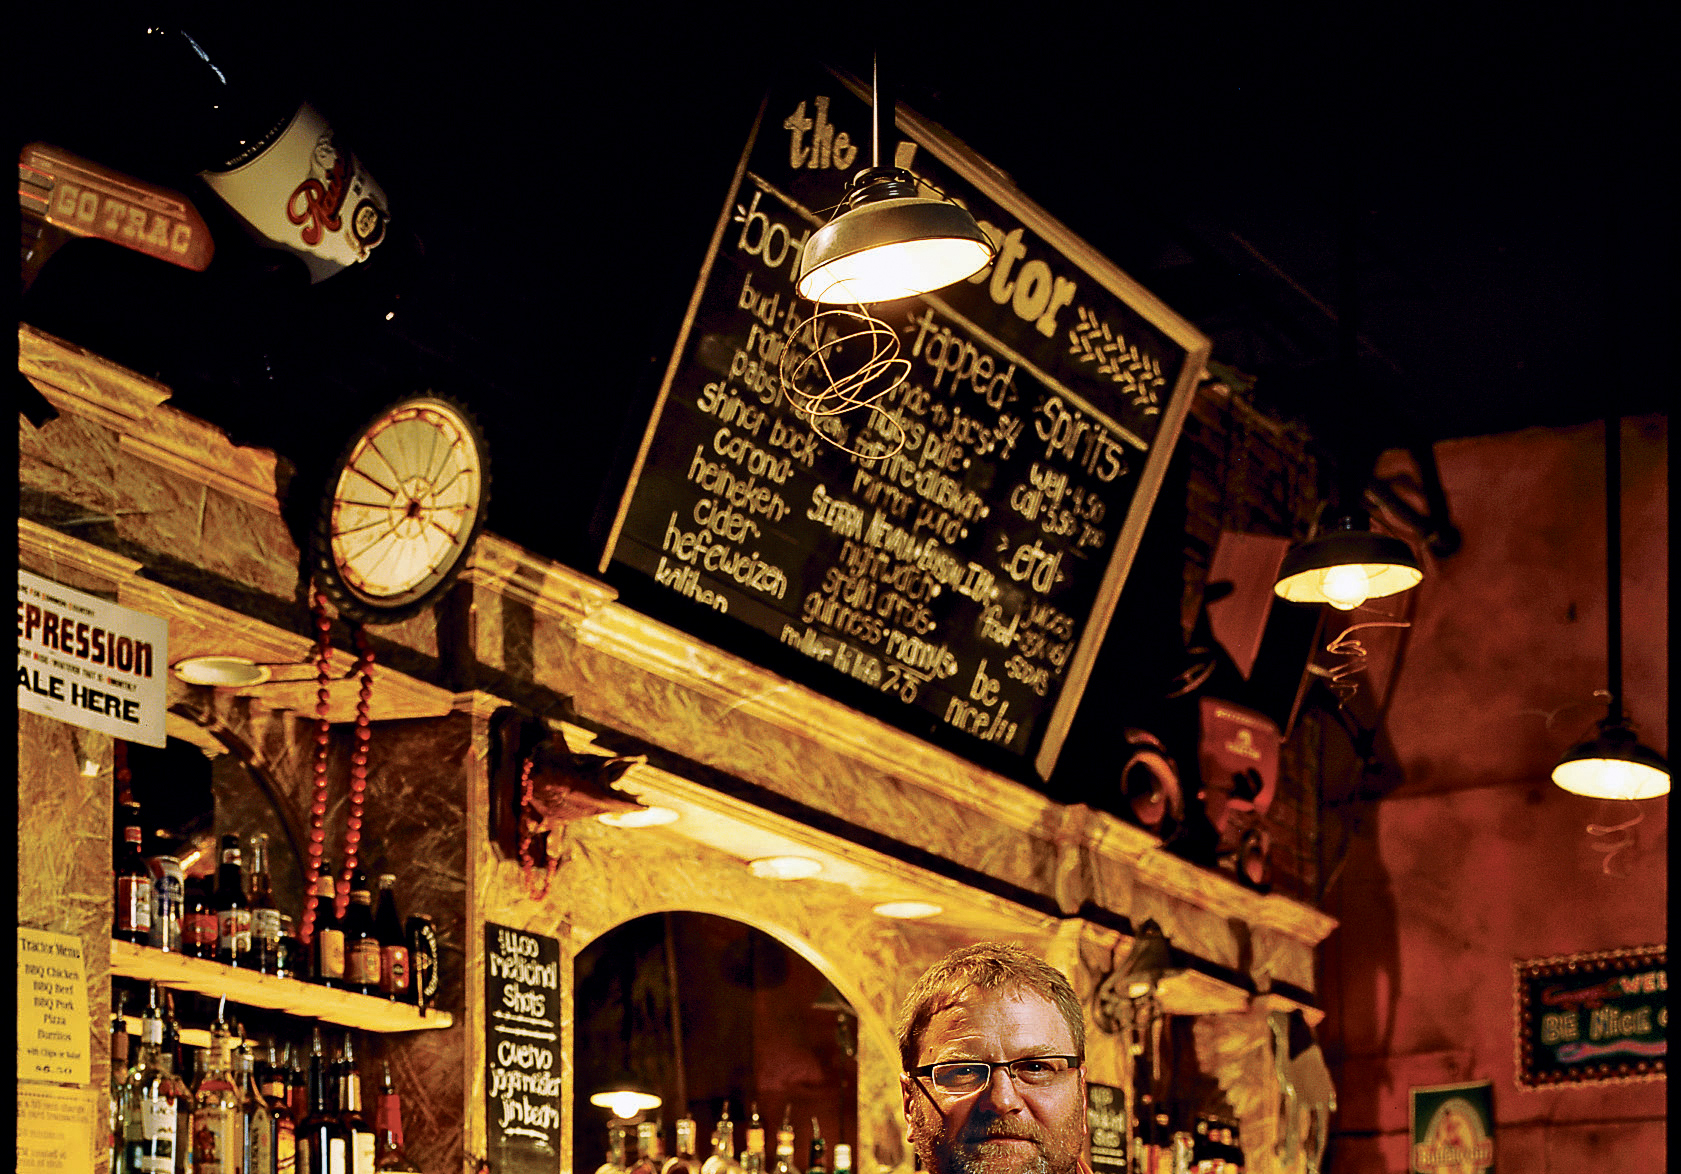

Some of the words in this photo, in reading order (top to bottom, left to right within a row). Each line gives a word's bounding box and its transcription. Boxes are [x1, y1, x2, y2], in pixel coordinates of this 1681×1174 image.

[783, 95, 858, 170] the
[58, 184, 100, 223] GO
[738, 272, 780, 326] bud
[728, 350, 792, 407] pabst
[912, 308, 1016, 410] tapped
[697, 381, 769, 436] shiner
[769, 417, 815, 467] bock
[687, 444, 786, 521] heineken
[713, 427, 786, 484] corona
[693, 498, 759, 544] cider
[1010, 484, 1044, 521] call
[662, 510, 788, 600] hefeweizen
[71, 682, 140, 724] HERE
[970, 658, 1000, 706] be
[1541, 1010, 1580, 1045] BE
